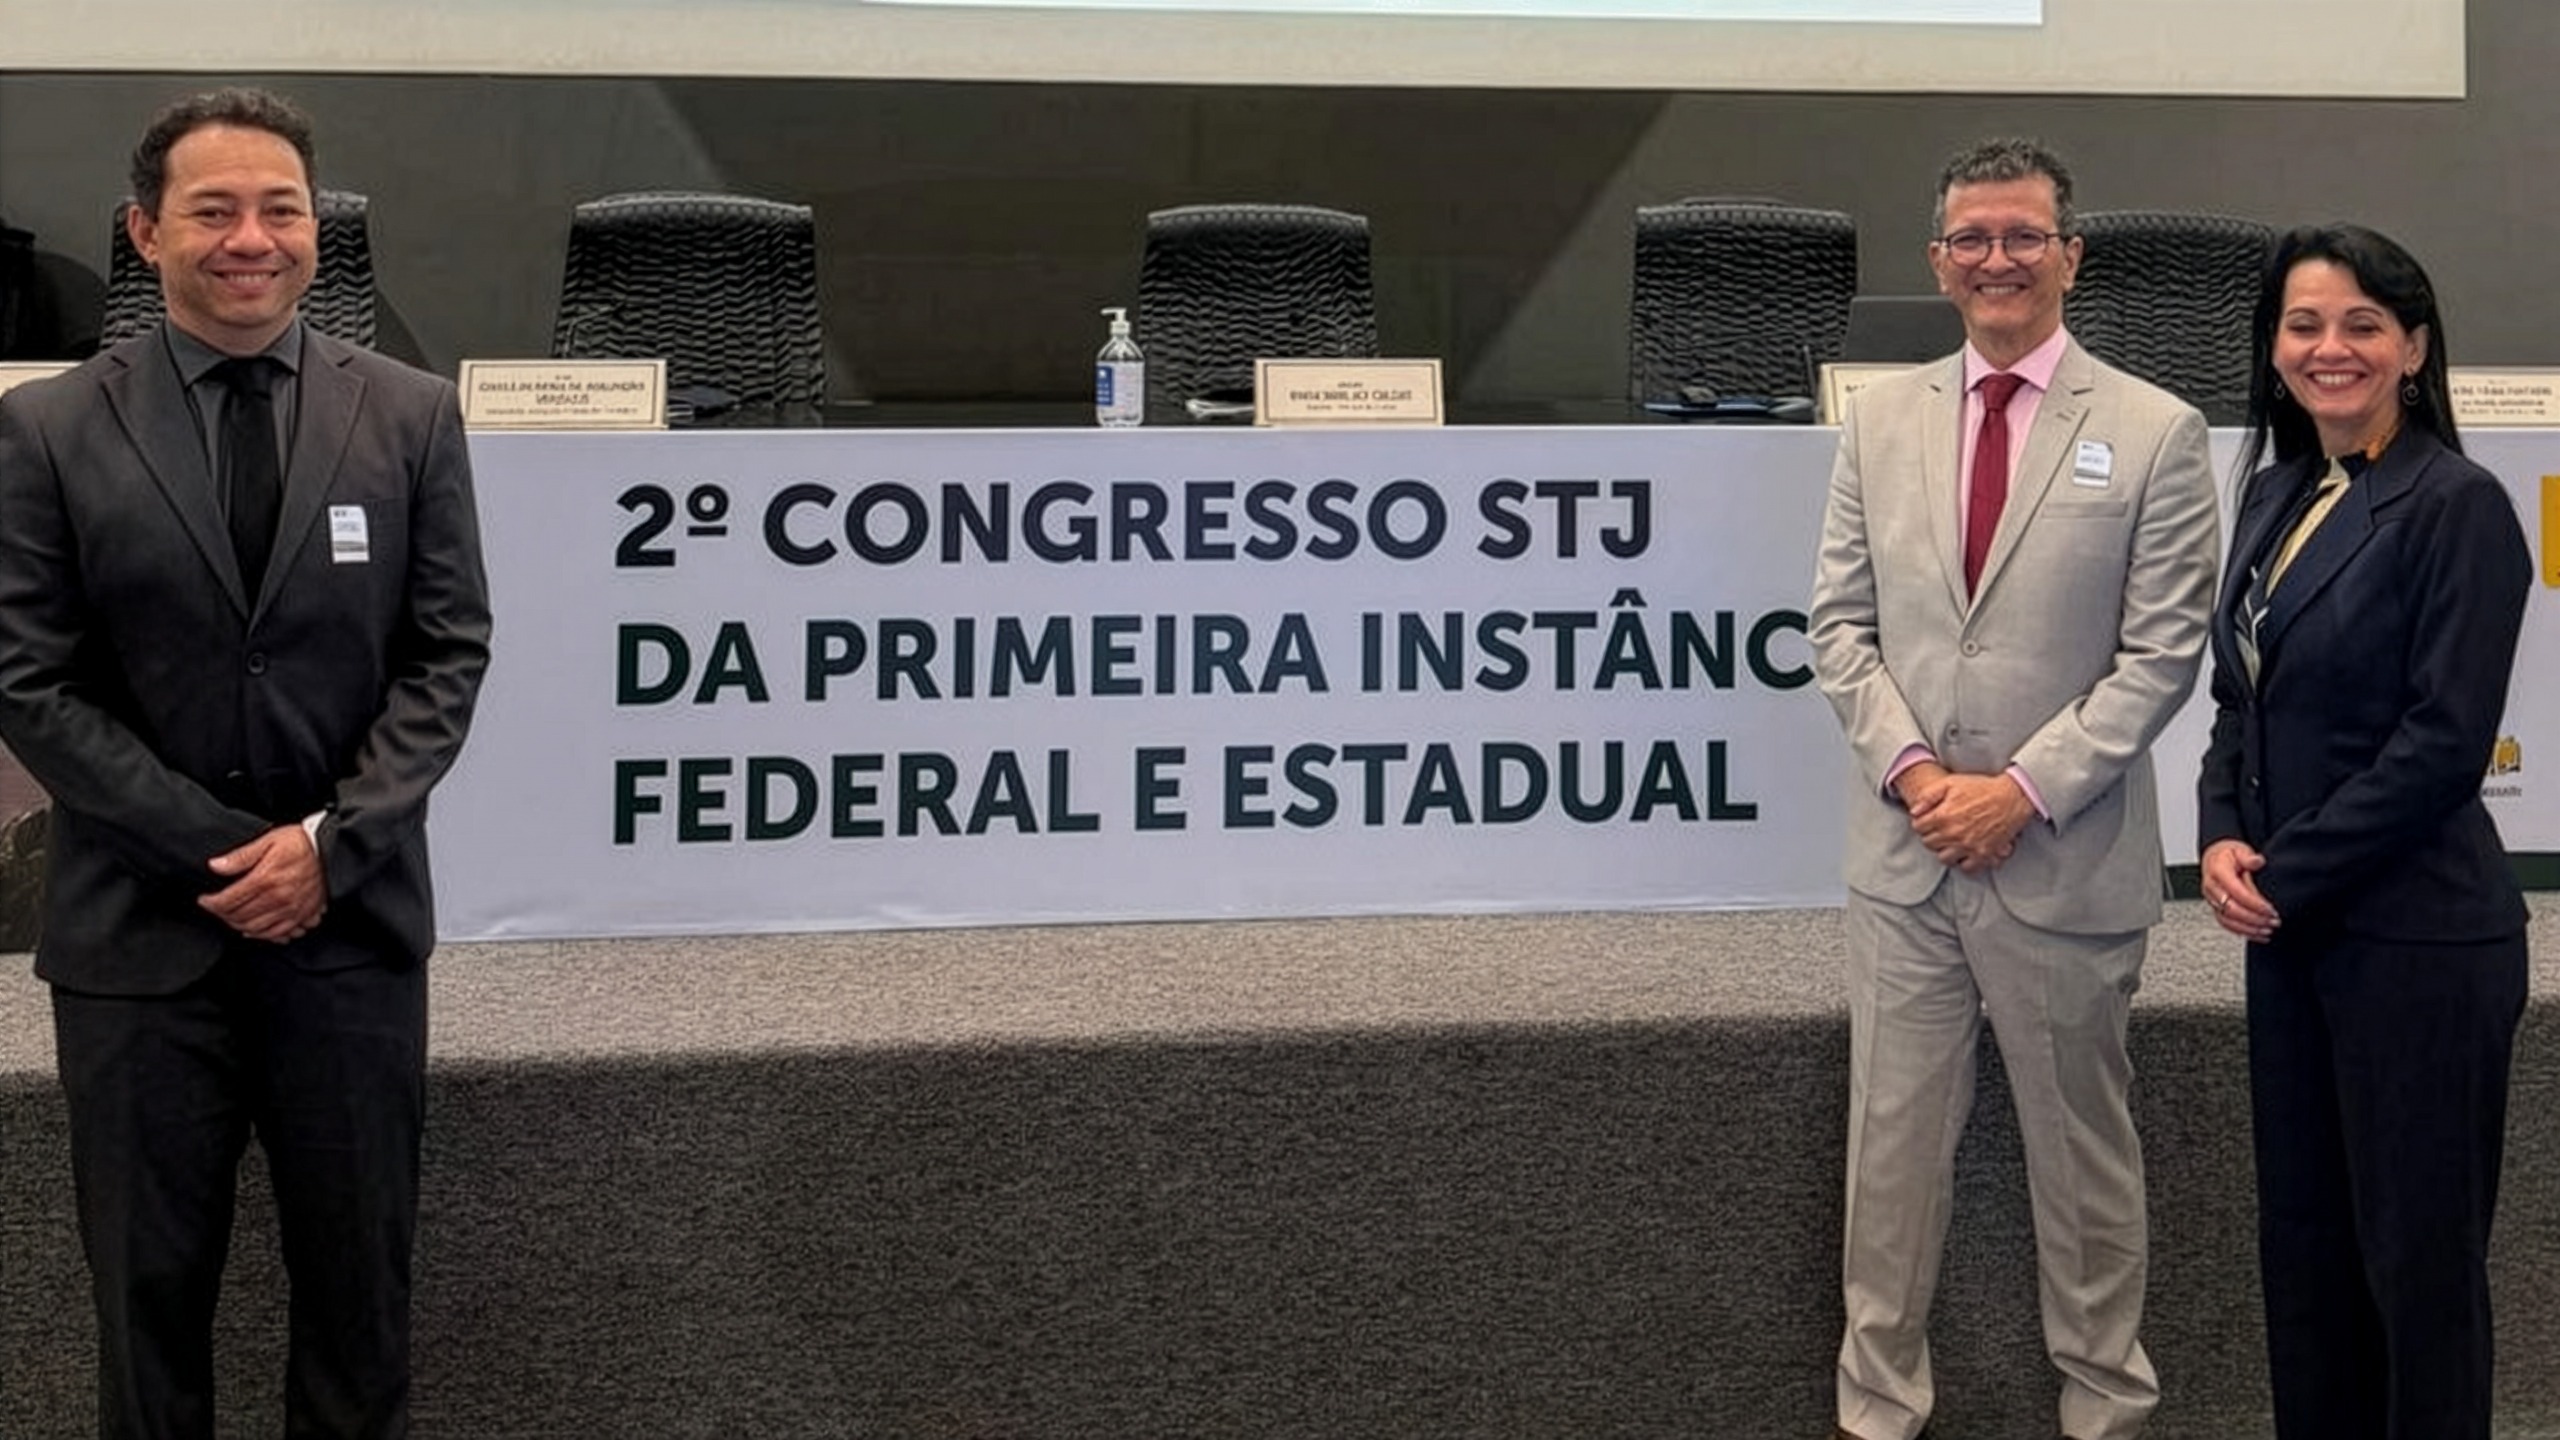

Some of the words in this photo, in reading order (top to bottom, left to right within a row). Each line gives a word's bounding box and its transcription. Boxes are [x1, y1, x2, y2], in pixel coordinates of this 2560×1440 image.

[615, 483, 730, 568] 2º
[763, 480, 1448, 567] CONGRESSO
[1478, 479, 1652, 560] STJ
[616, 621, 771, 707] DA
[804, 613, 1330, 702] PRIMEIRA
[1362, 587, 1816, 692] INSTÂNC
[613, 750, 1101, 846] FEDERAL
[1134, 746, 1187, 831] E
[1223, 739, 1759, 829] ESTADUAL
